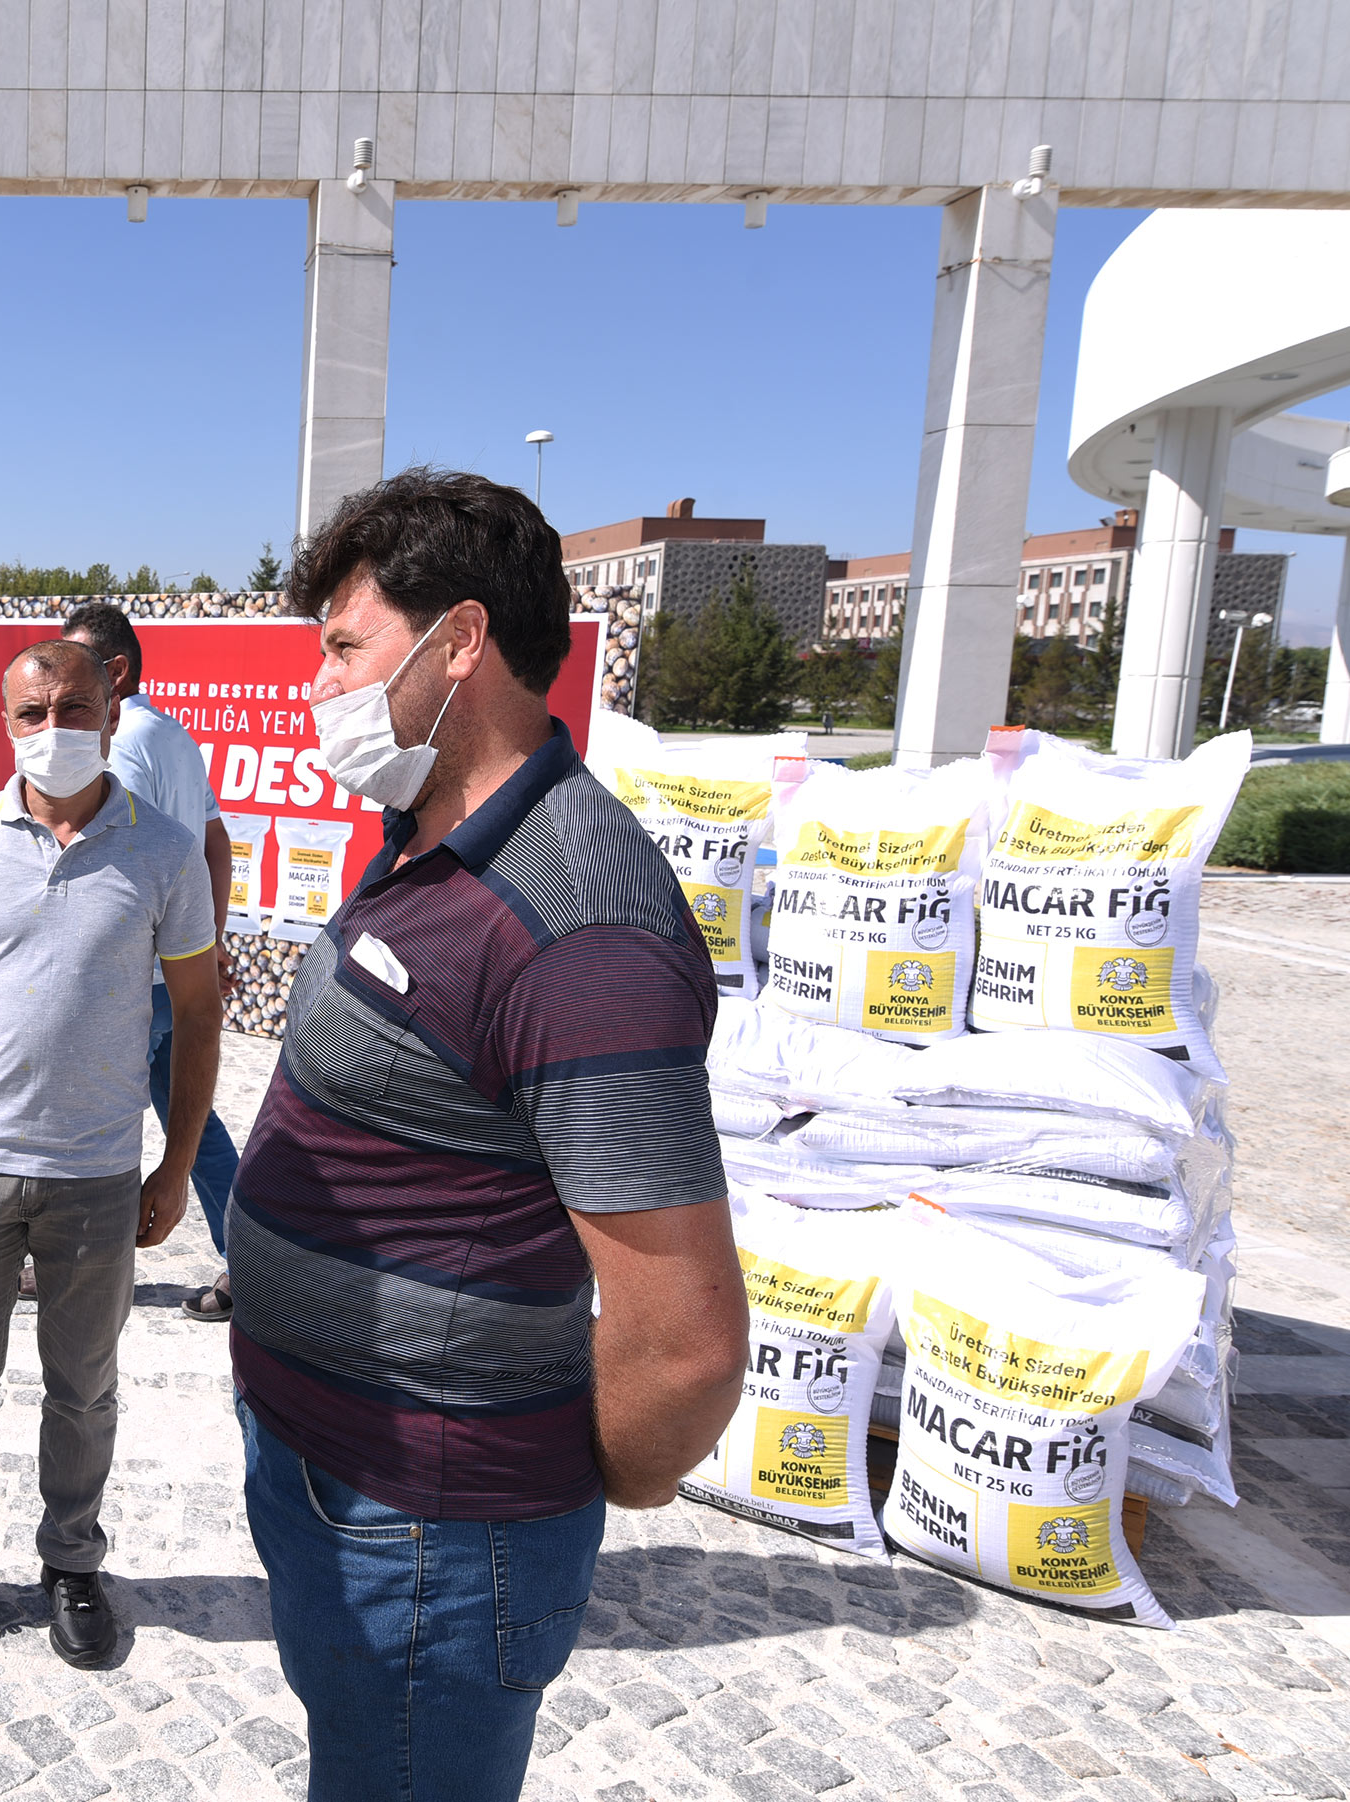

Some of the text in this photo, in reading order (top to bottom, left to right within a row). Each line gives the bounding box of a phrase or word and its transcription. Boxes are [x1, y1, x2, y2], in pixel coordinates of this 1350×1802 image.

[138, 679, 200, 698] SİZDEN
[208, 682, 279, 700] DESTEK
[259, 710, 306, 736] YEM
[688, 786, 732, 800] Sizden
[878, 839, 924, 854] Sizden
[982, 878, 1095, 917] MACAR
[849, 930, 865, 942] 25
[868, 932, 887, 944] KG
[1026, 924, 1096, 940] NET 25 KG
[890, 994, 929, 1005] KONYA
[1099, 995, 1144, 1005] KONYA
[869, 1003, 947, 1018] BÜYÜKŞEHİR
[1077, 1003, 1165, 1018] BÜYÜKŞEHİR
[884, 1017, 932, 1026] BELEDİYESİ
[1097, 1018, 1152, 1028] BELEDİYESİ
[781, 1281, 835, 1300] Sizden
[1024, 1358, 1087, 1380] Sizden
[760, 1386, 781, 1401] KG
[907, 1384, 1032, 1473] MACAR
[781, 1461, 823, 1475] KONYA
[758, 1470, 841, 1491] BÜYÜKŞEHİR
[953, 1462, 1033, 1497] NET 25 KG
[775, 1486, 826, 1500] BELEDİYESİ
[683, 1484, 713, 1503] PARA
[733, 1500, 800, 1530] SATILAMAZ
[1041, 1557, 1088, 1567] KONYA
[1016, 1561, 1111, 1581] BÜYÜKŞEHİR
[1038, 1579, 1096, 1588] BELEDİYESİ
